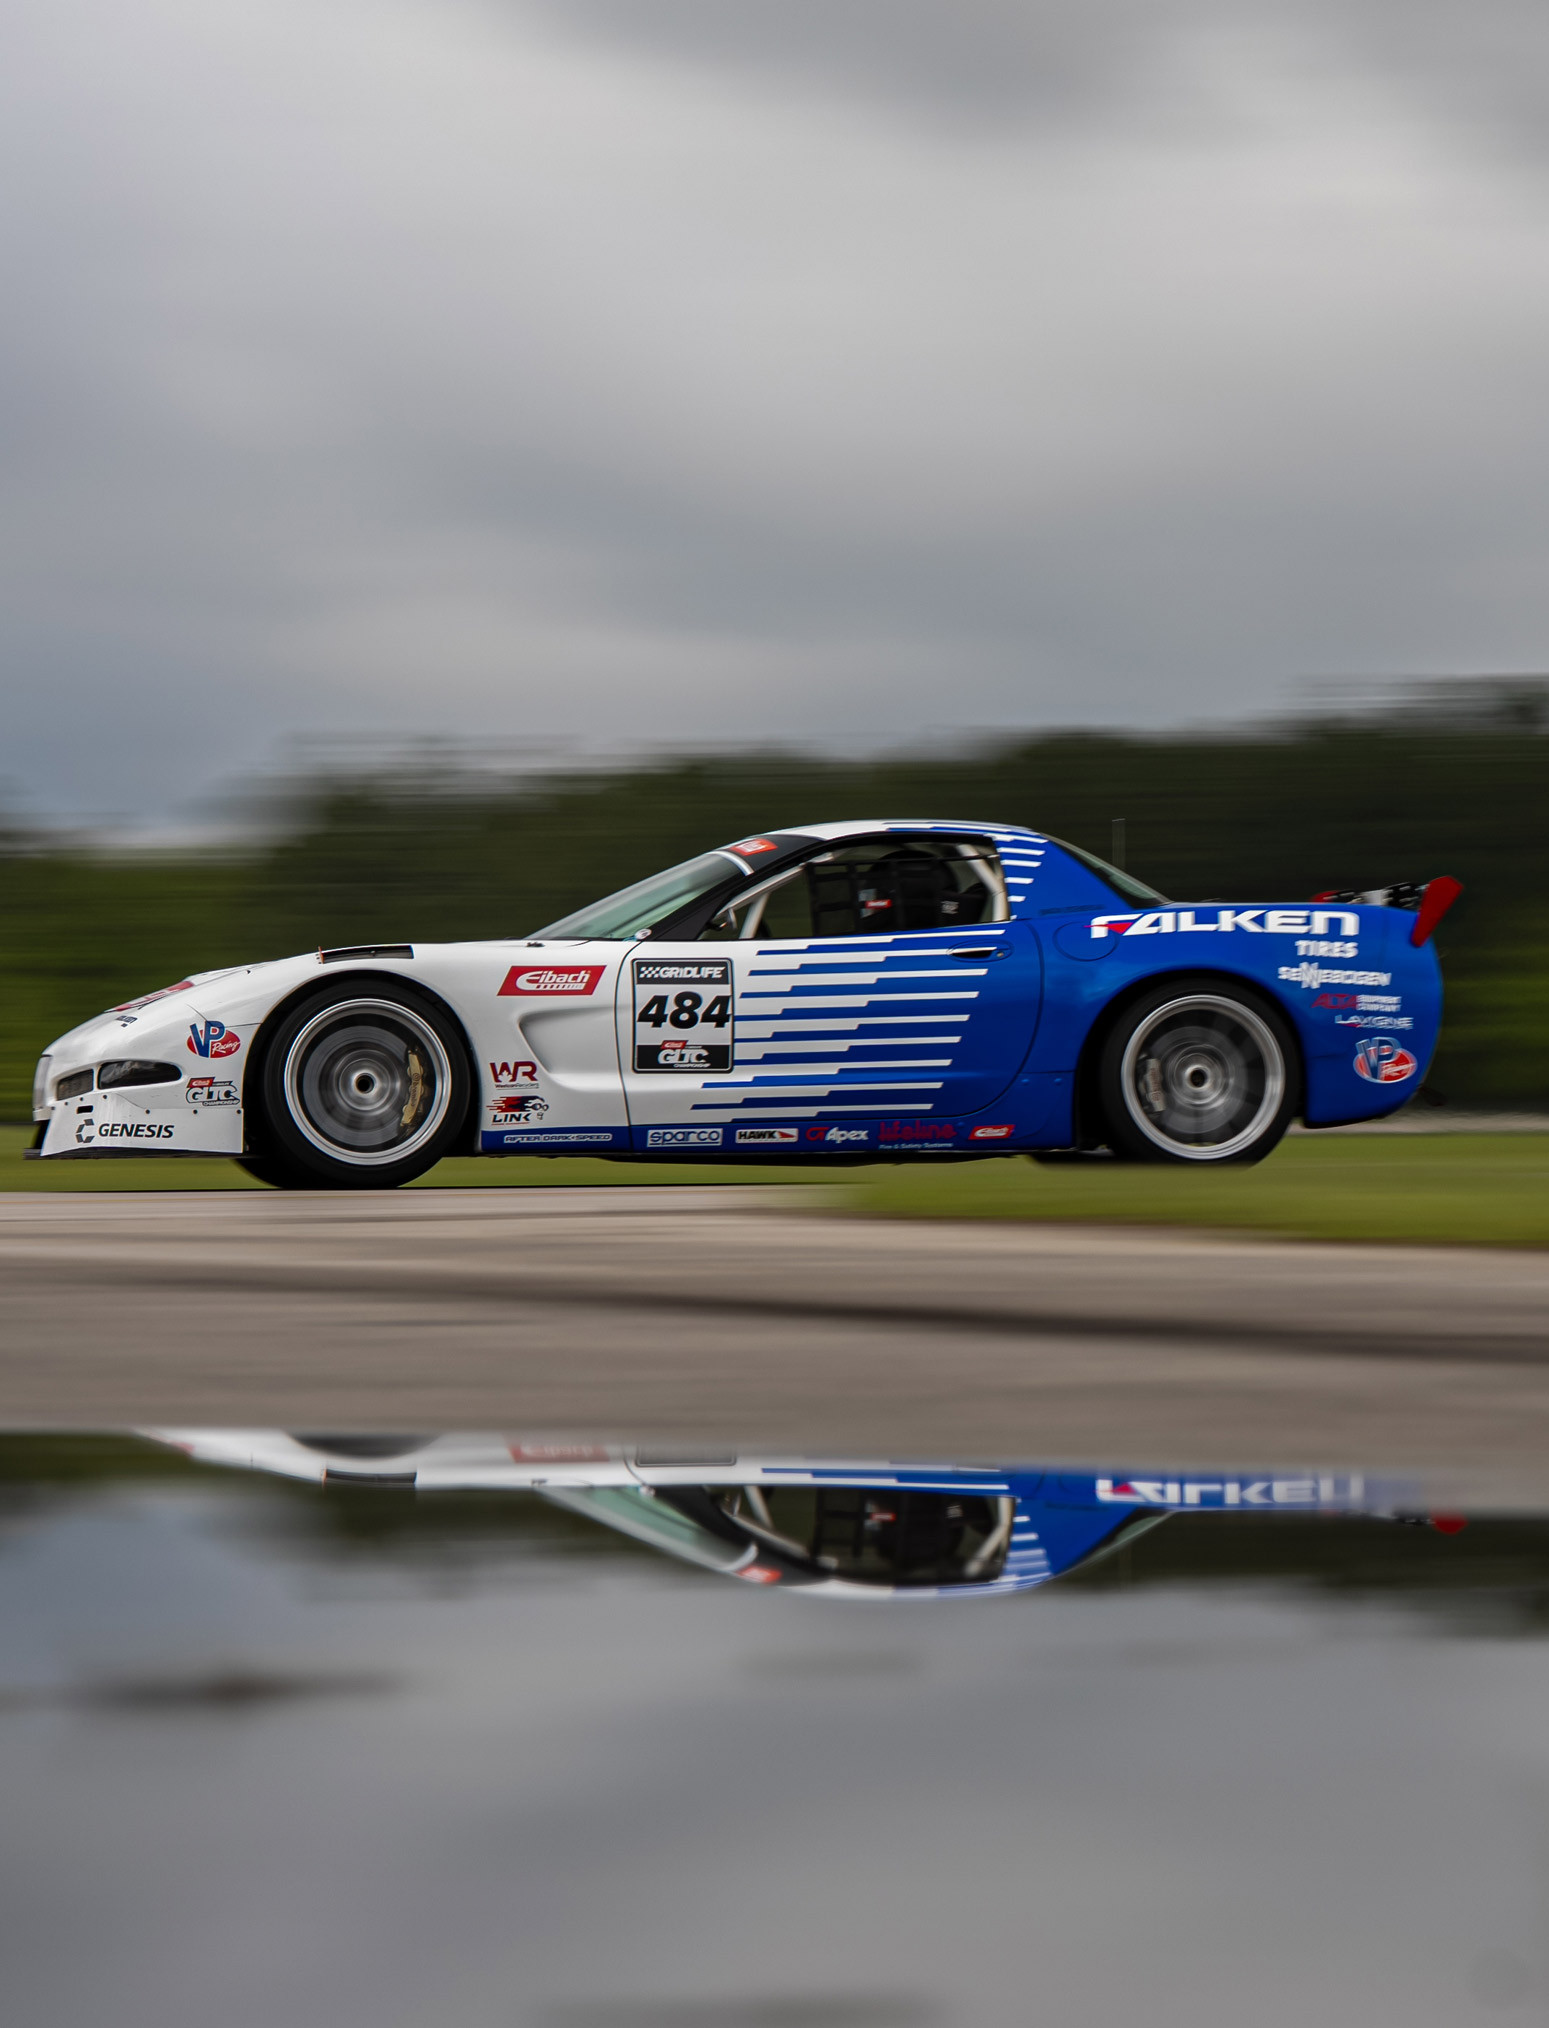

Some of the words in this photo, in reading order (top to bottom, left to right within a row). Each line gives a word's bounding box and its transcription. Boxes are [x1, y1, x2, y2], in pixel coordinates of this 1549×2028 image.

[1090, 910, 1360, 938] FALKEN
[1295, 940, 1358, 957] TIRES
[516, 970, 590, 990] Eibach
[659, 967, 725, 978] GRIDLIFE
[637, 991, 732, 1029] 484
[190, 1021, 225, 1058] VP
[211, 1041, 241, 1055] Racing
[489, 1061, 538, 1083] WR
[492, 1113, 532, 1123] LINK
[98, 1123, 175, 1138] GENESIS
[650, 1130, 720, 1144] sparco
[738, 1130, 777, 1140] HAWK
